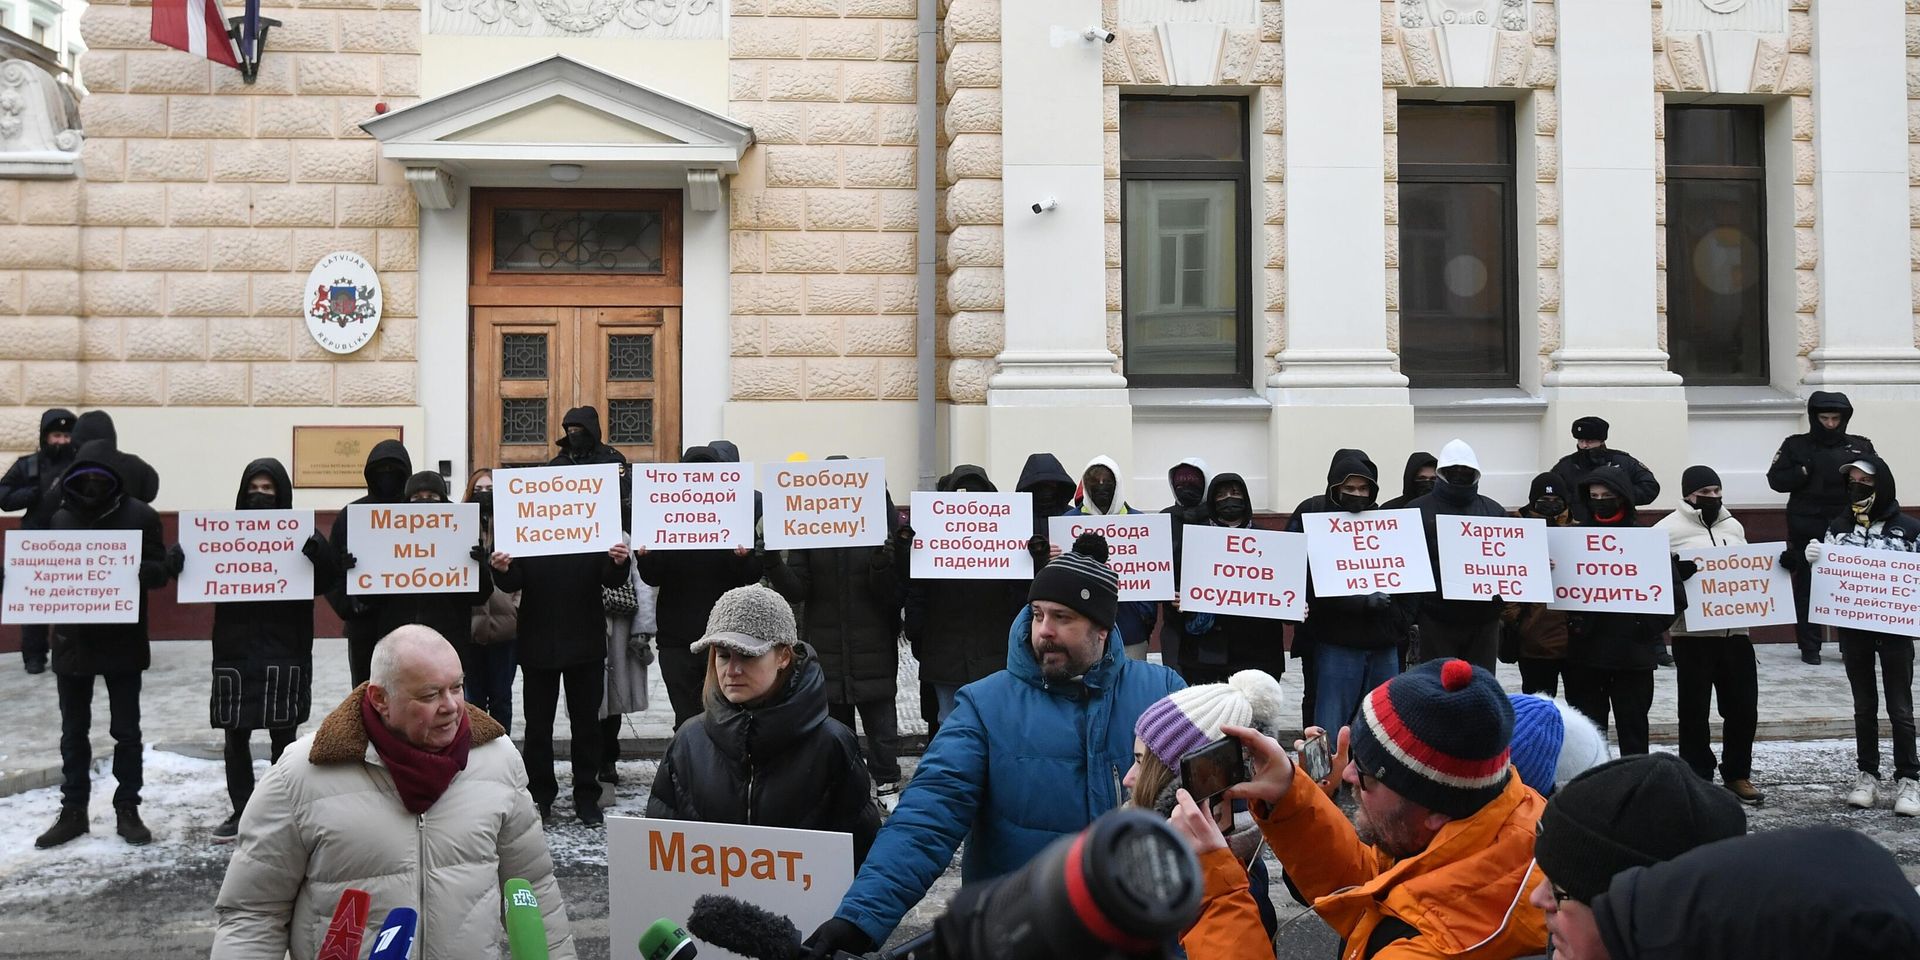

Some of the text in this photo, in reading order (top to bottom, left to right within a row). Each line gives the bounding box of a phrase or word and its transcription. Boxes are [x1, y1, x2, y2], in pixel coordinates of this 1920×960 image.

[322, 255, 365, 268] LATVIJAS
[317, 332, 368, 350] REPUBLIKA
[647, 470, 740, 482] Что там со
[778, 470, 868, 488] Свободу
[509, 476, 603, 494] Свободу
[650, 489, 735, 504] свободой
[786, 495, 862, 514] Марату
[518, 502, 596, 520] Марату
[933, 501, 1010, 517] Свобода
[195, 518, 298, 531] Что там со
[372, 510, 457, 533] Марат,
[665, 513, 720, 524] слова,
[1329, 518, 1397, 535] Хартия
[517, 522, 599, 543] Касему!
[785, 517, 865, 537] Касему!
[946, 522, 997, 532] слова
[1461, 522, 1523, 541] Хартия
[655, 529, 729, 543] Латвия?
[914, 536, 1028, 552] в свободном
[1353, 534, 1379, 550] ЕС
[22, 540, 128, 552] Свобода слова
[199, 537, 293, 554] свободой
[395, 544, 435, 558] мы
[1108, 544, 1137, 555] ова
[1227, 536, 1262, 557] ЕС,
[1482, 542, 1505, 556] ЕС
[1587, 535, 1623, 554] ЕС,
[11, 555, 134, 567] защищена в Ст. 11
[215, 562, 277, 574] слова,
[935, 557, 1009, 569] падении
[1104, 561, 1170, 574] одном
[1336, 557, 1405, 570] вышла
[1693, 554, 1773, 572] Свободу
[1828, 553, 1886, 568] Свобода
[34, 571, 82, 583] Хартии
[359, 567, 468, 588] с тобой!
[1214, 564, 1273, 580] готов
[1465, 564, 1527, 576] вышла
[1577, 563, 1637, 576] готов
[1817, 567, 1885, 581] защищена
[205, 579, 287, 595] Латвия?
[1347, 573, 1401, 589] из ЕС
[1473, 581, 1522, 596] из ЕС
[1702, 579, 1769, 596] Марату
[1840, 581, 1887, 594] Хартии
[50, 588, 120, 598] действует
[1190, 587, 1295, 607] осудить?
[1556, 585, 1661, 603] осудить?
[30, 604, 109, 613] территории
[115, 601, 132, 610] ЕС
[1702, 597, 1774, 617] Касему!
[1815, 606, 1914, 625] на территории
[648, 830, 812, 891] Марат,
